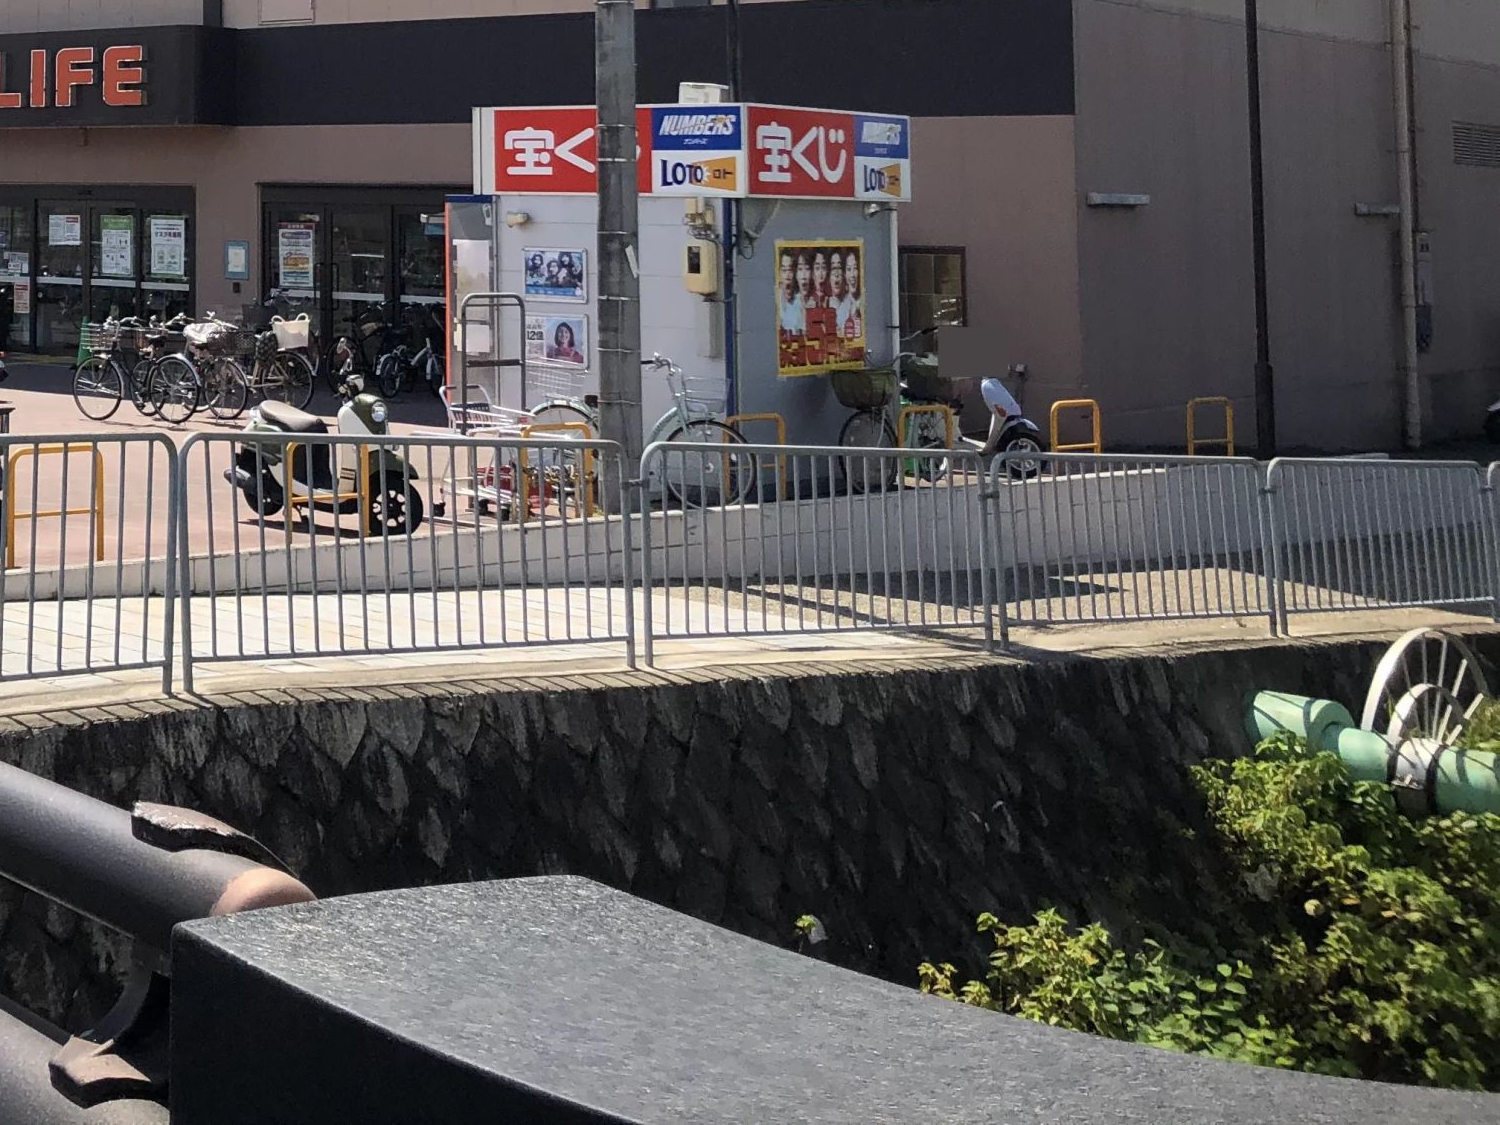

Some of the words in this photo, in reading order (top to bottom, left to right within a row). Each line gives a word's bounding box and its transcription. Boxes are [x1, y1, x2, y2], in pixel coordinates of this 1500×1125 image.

[659, 114, 737, 136] NUMBERS
[504, 126, 641, 176] 宝く
[756, 121, 847, 184] 宝くじ
[660, 158, 704, 187] LOTO
